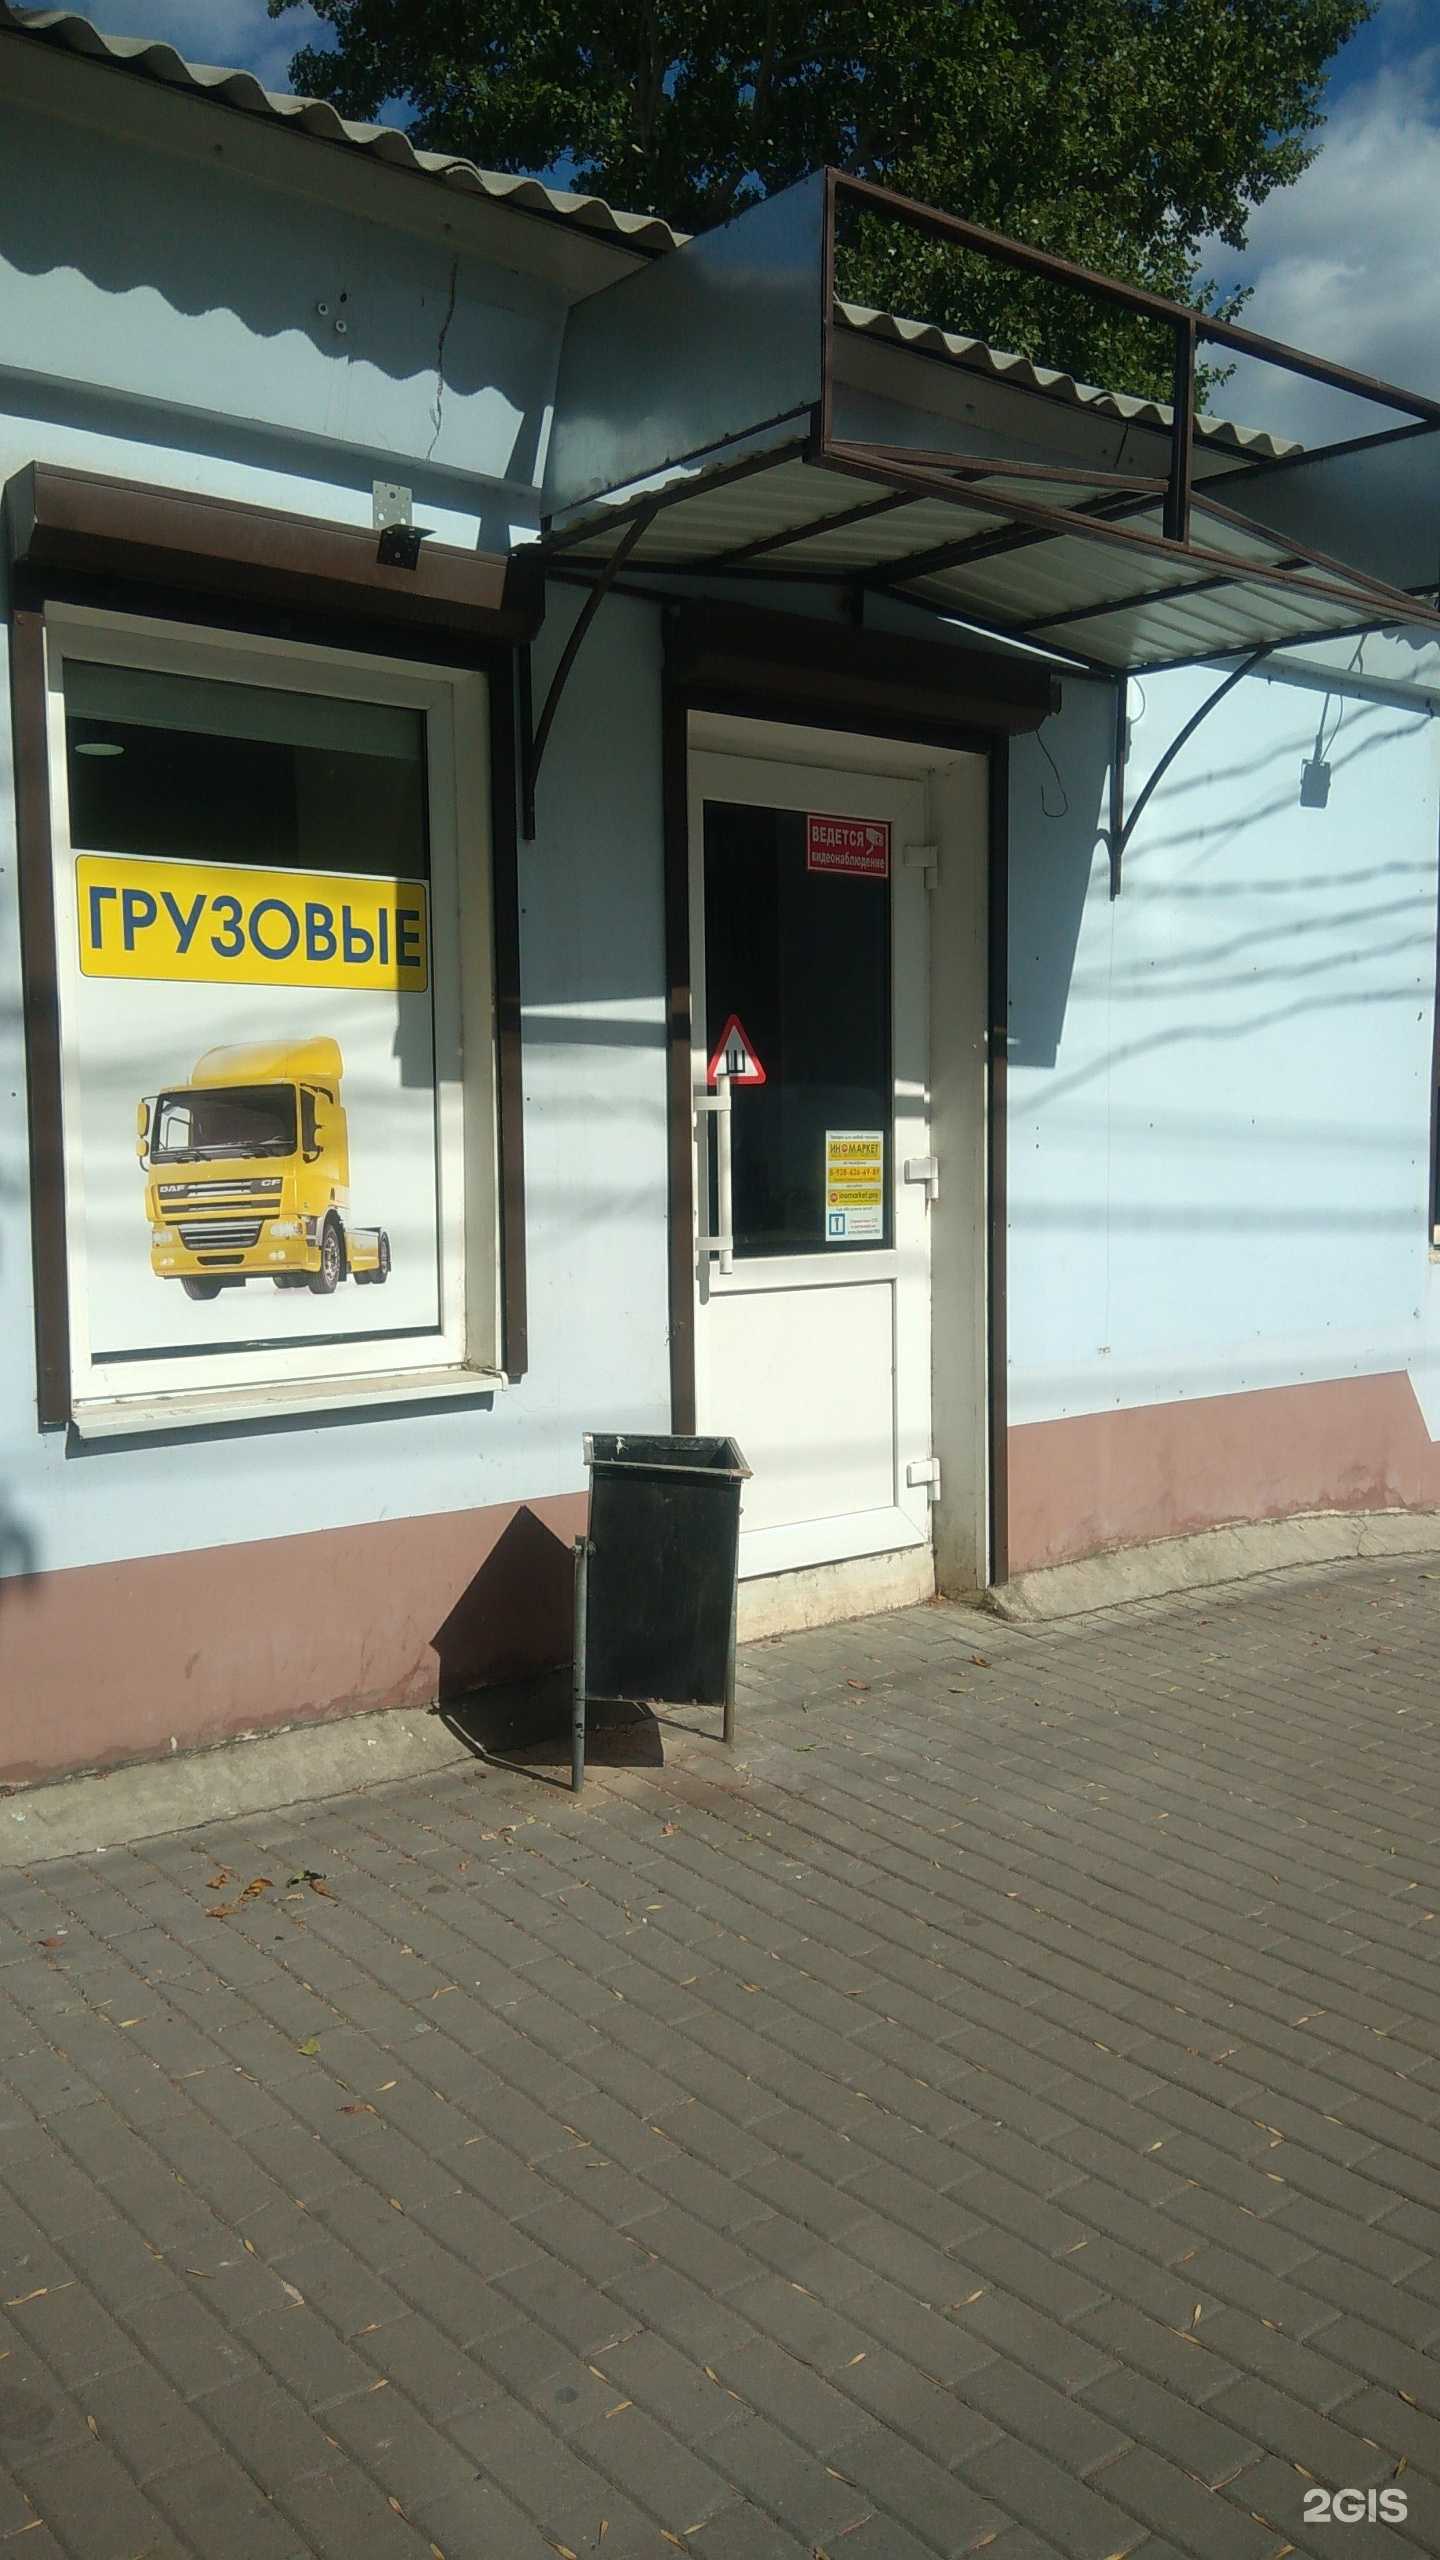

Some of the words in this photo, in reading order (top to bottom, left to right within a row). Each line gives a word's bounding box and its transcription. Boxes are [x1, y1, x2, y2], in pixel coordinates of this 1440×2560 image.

[812, 826, 864, 847] ВЕДЕТСЯ
[811, 851, 885, 869] видеонаблюдение
[89, 885, 421, 967] ГРУЗОВЫЕ
[159, 1184, 186, 1193] DAF
[261, 1179, 281, 1187] CF
